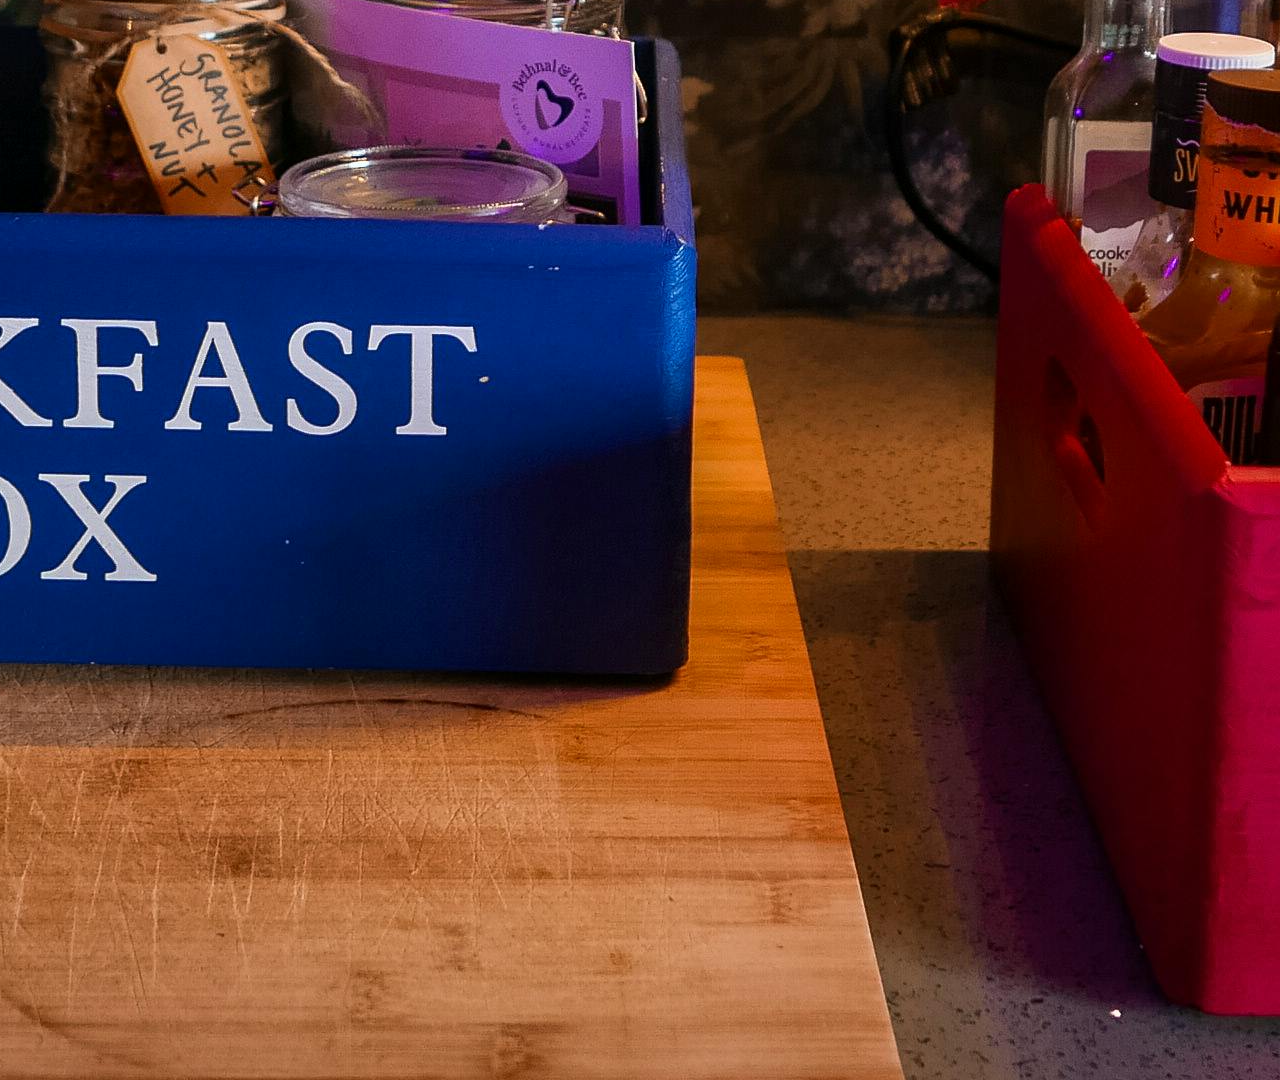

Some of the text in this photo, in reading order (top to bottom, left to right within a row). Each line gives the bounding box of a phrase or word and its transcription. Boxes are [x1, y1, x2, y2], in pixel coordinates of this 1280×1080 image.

[146, 67, 210, 152] HONEY
[180, 53, 262, 190] GRANOLA
[149, 141, 208, 197] NUT
